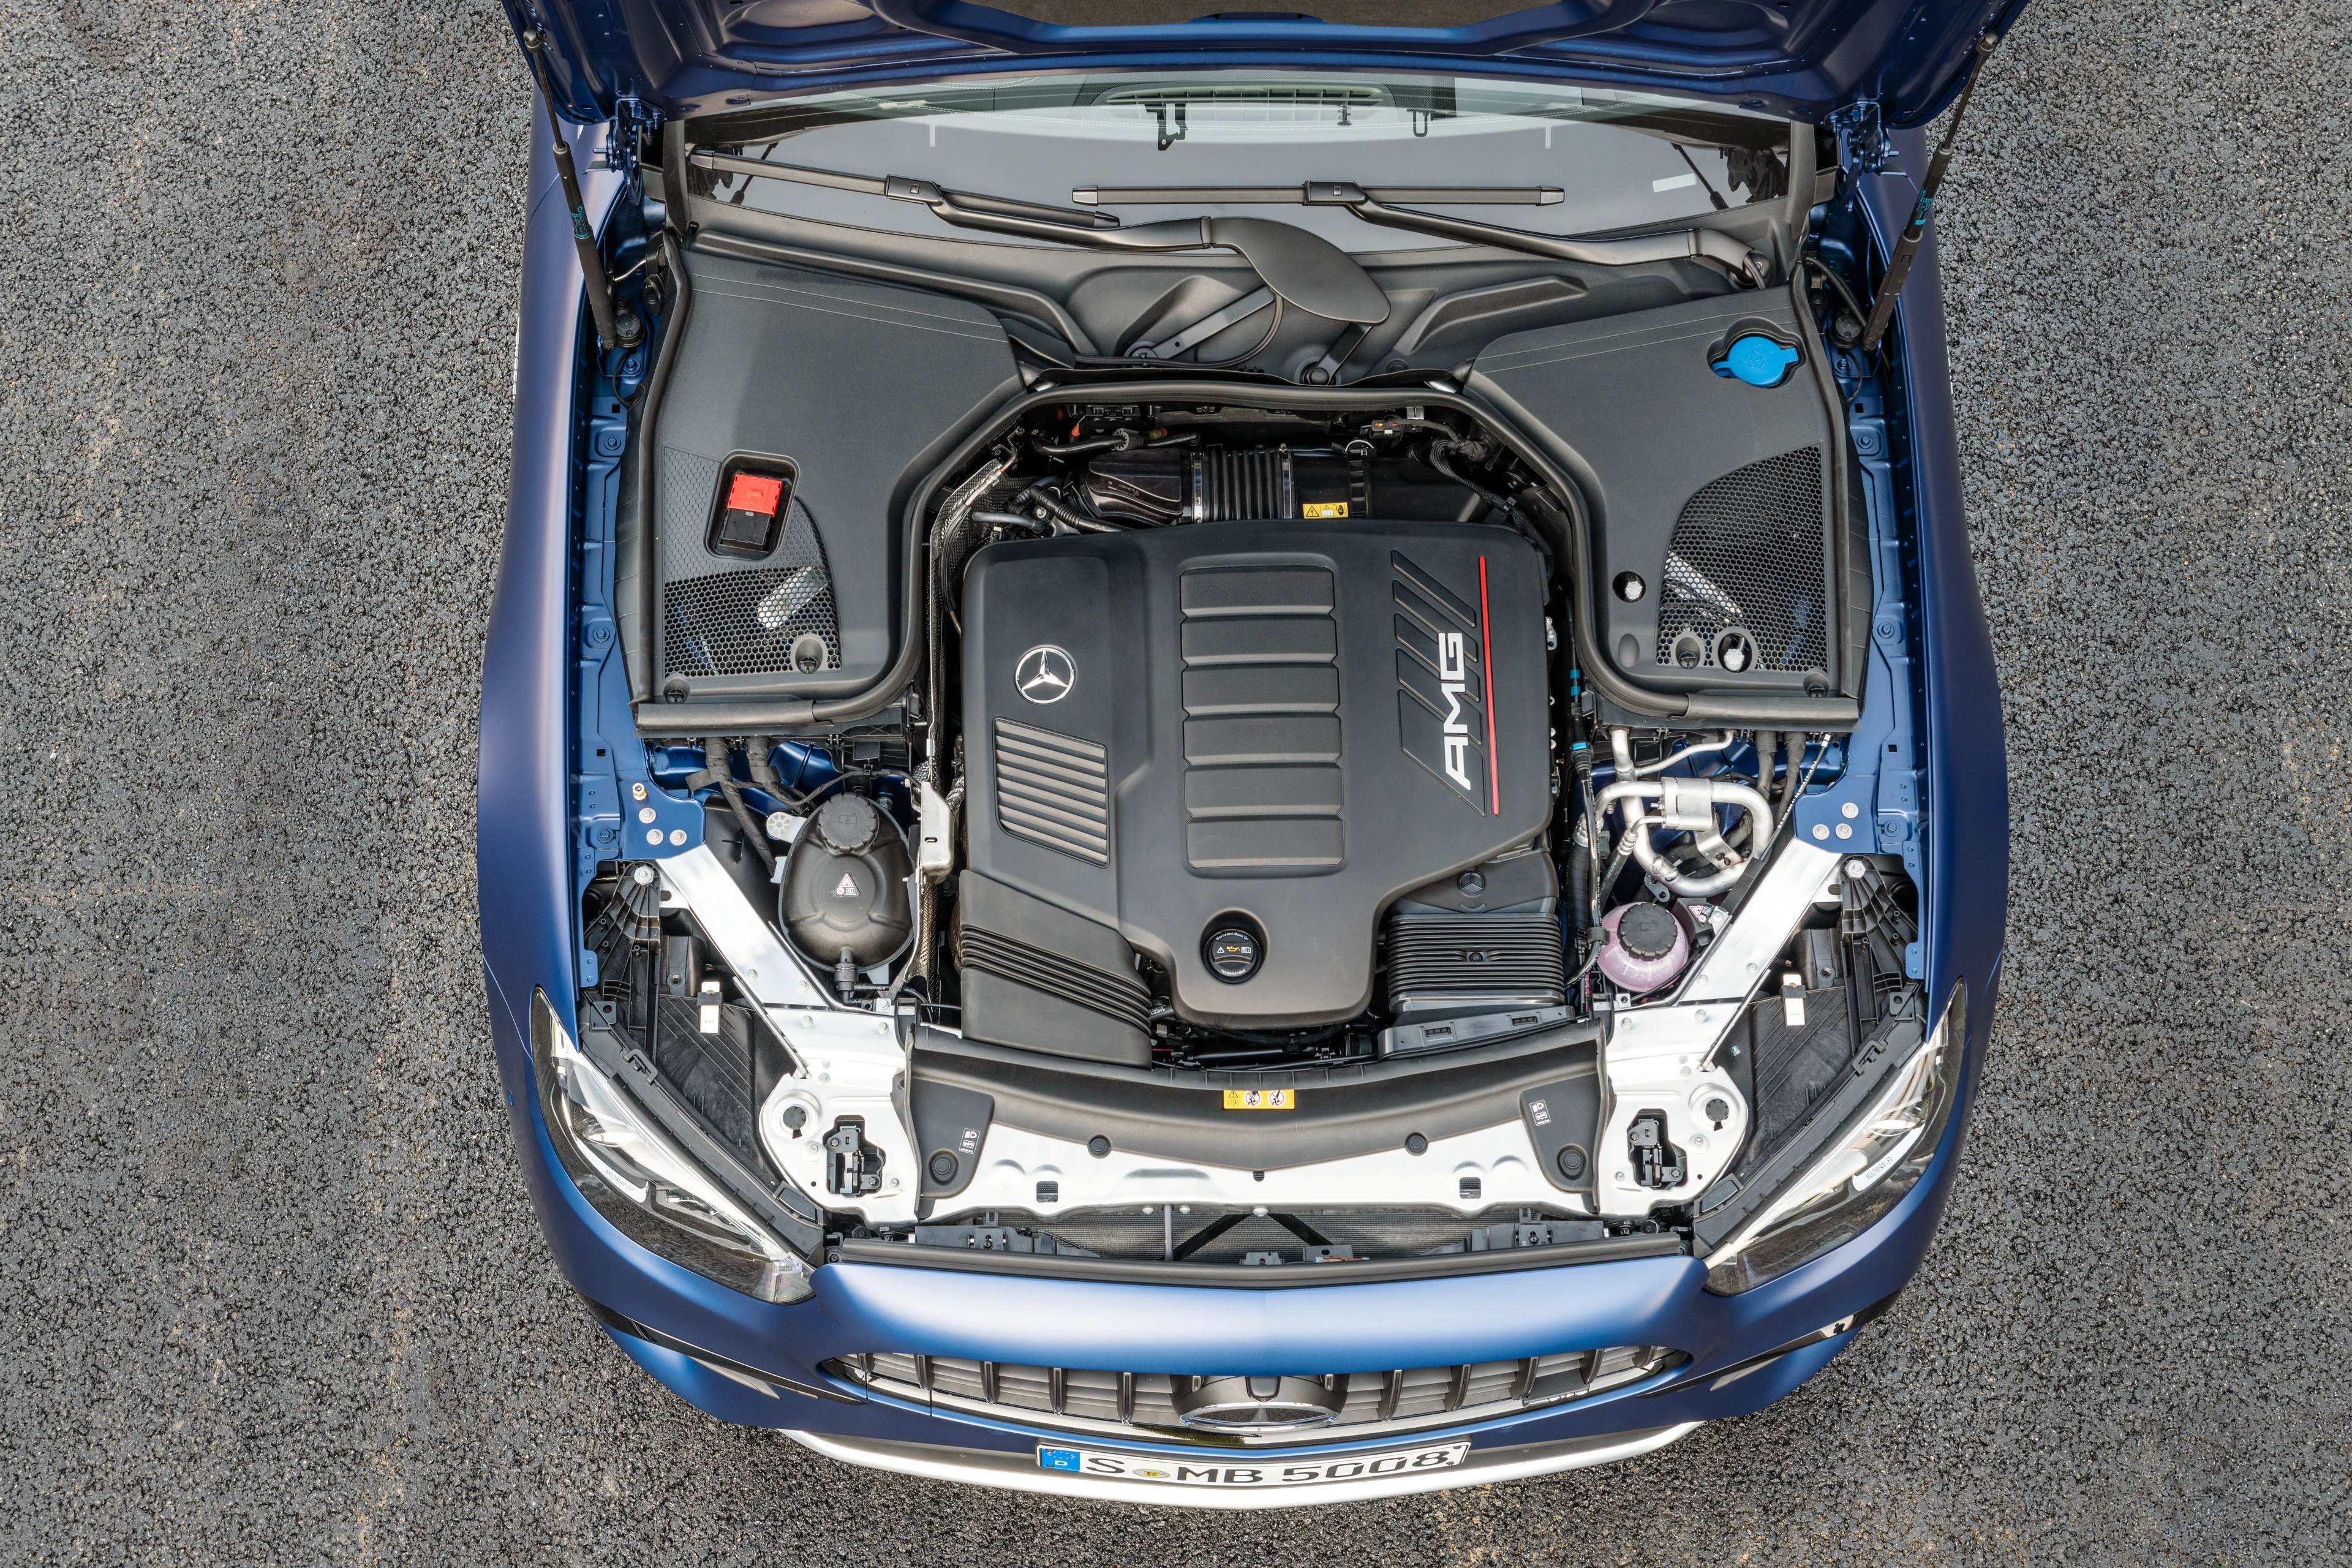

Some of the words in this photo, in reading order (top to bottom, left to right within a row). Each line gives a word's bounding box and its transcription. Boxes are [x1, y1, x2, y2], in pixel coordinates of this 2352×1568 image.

[1438, 633, 1471, 790] AMG
[1215, 932, 1243, 941] Mercedes-Benz
[605, 1169, 627, 1187] MULTIBEAM
[1864, 1162, 1887, 1180] MULTIBEAM
[1086, 1458, 1125, 1474] S
[1177, 1466, 1263, 1483] MB
[1281, 1451, 1450, 1482] 5008
